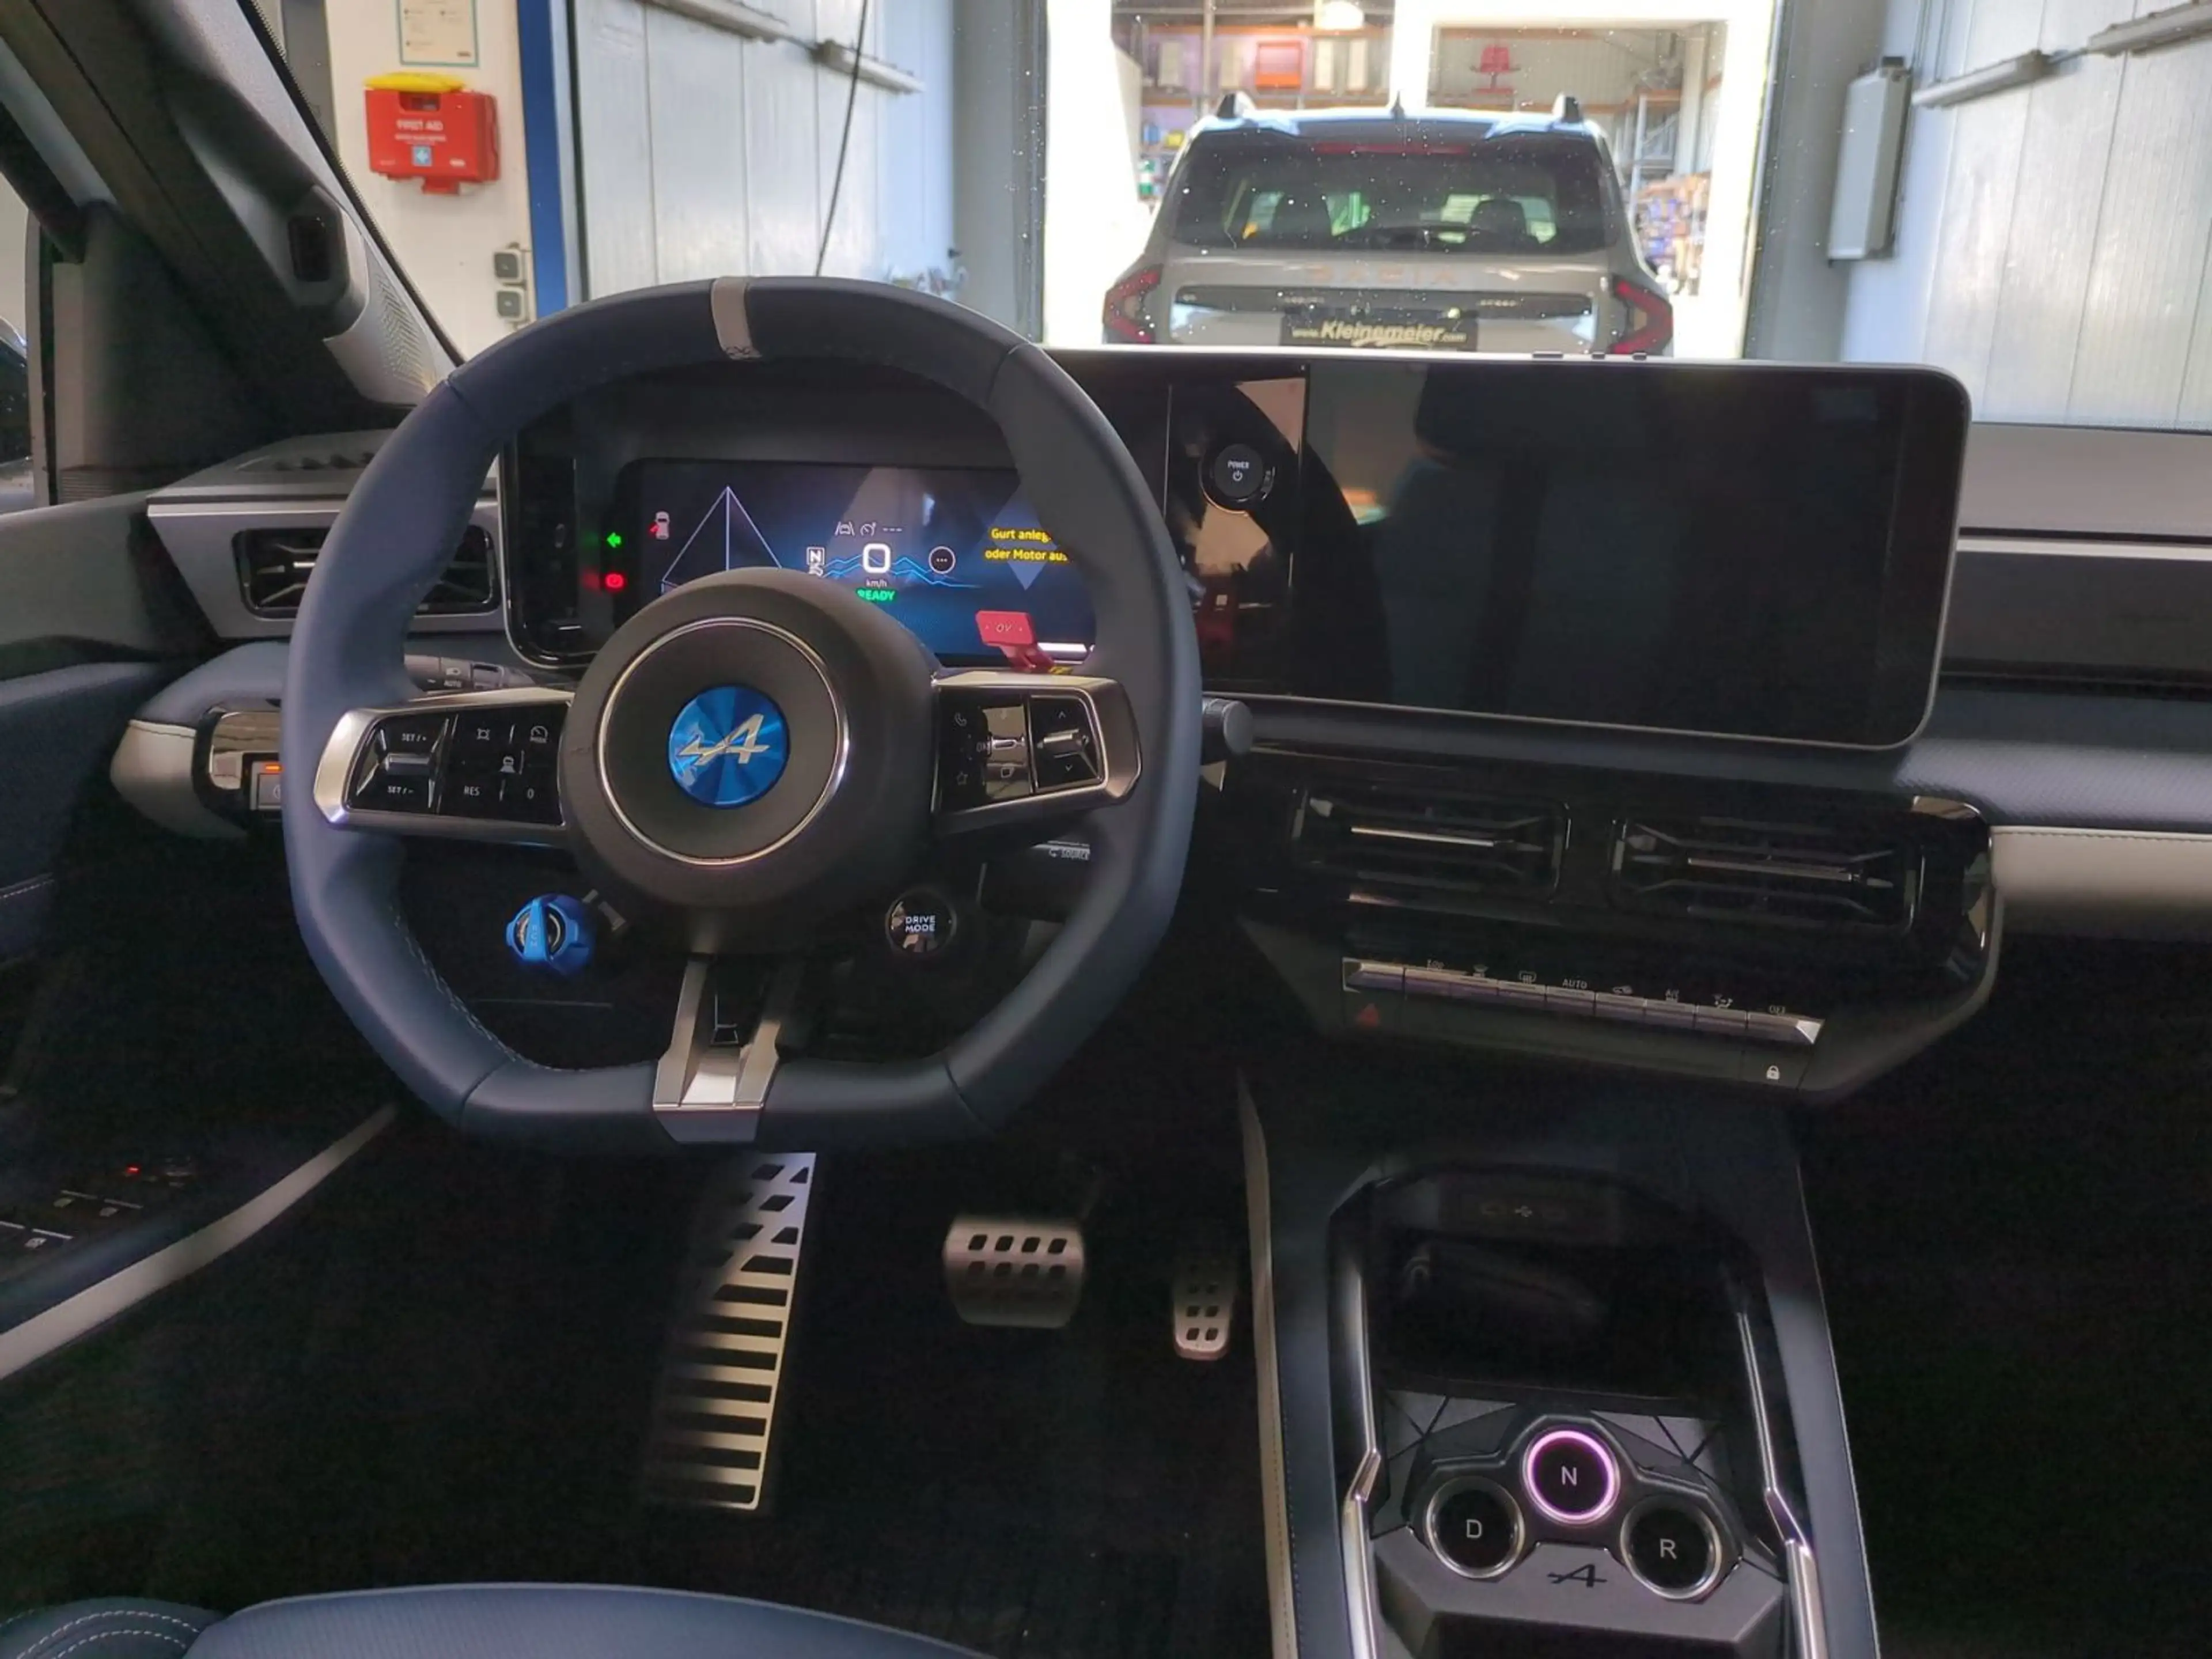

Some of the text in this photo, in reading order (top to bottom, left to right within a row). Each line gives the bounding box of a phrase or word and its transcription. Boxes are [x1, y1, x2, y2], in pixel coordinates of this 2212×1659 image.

[991, 528, 1051, 543] Gurt anleg
[810, 550, 821, 563] N
[985, 549, 1010, 559] oder
[1013, 549, 1047, 560] Motor
[866, 579, 888, 588] km/h
[464, 786, 480, 796] RES
[906, 915, 935, 924] DRIVE
[905, 923, 935, 933] MODE
[1562, 979, 1587, 989] AUTO
[1561, 1466, 1578, 1487] N
[1466, 1519, 1483, 1539] D
[1660, 1539, 1677, 1560] R
